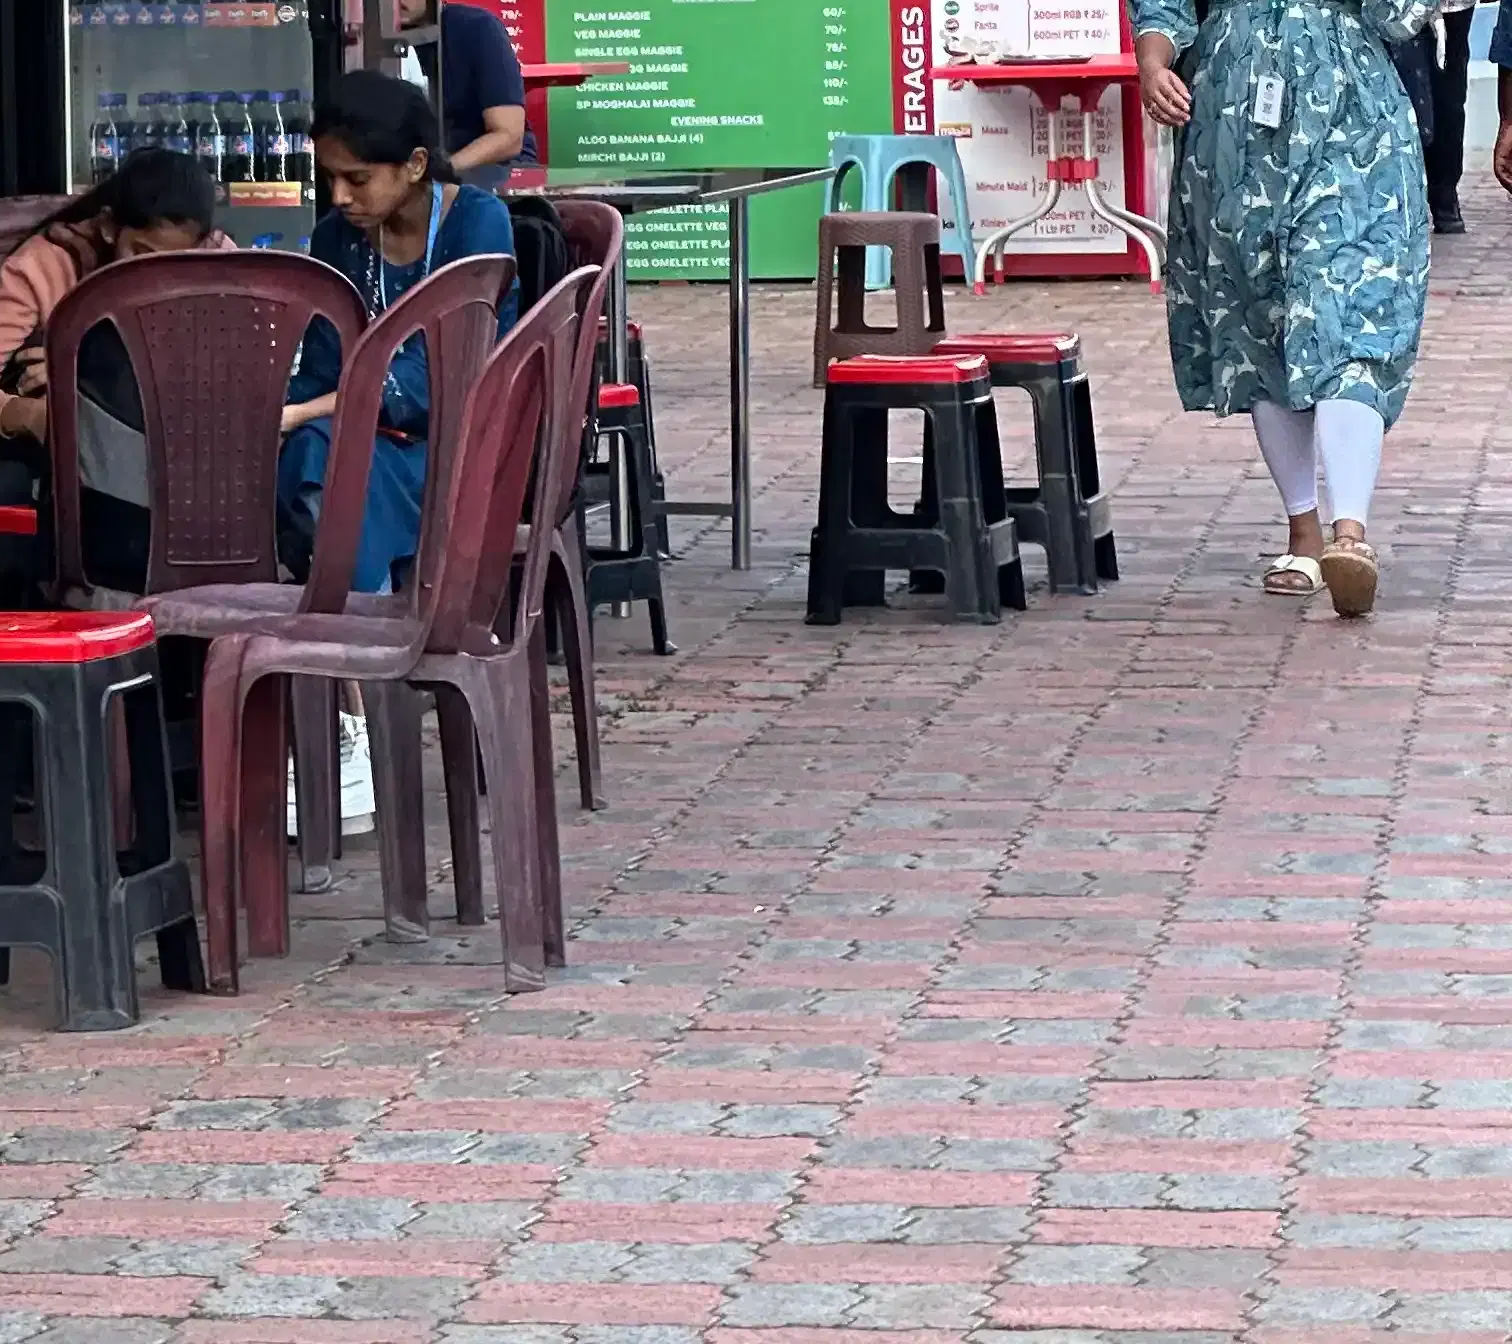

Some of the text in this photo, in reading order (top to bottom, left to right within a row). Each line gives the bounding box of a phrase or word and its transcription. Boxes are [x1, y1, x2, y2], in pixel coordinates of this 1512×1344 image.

[574, 12, 607, 22] PLAIN
[608, 11, 651, 21] MAGGIE
[974, 21, 998, 31] Fanta
[574, 30, 597, 39] VEG
[599, 29, 641, 39] MAGGIE
[575, 47, 614, 57] SINGLE
[616, 47, 638, 56] EGG
[640, 46, 683, 56] MAGGIE
[646, 63, 688, 73] MAGGIE
[576, 81, 623, 92] CHICKEN
[626, 81, 668, 91] MAGGIE
[653, 98, 696, 108] MAGGIE
[670, 114, 764, 127] EVENING SNACKS
[578, 135, 607, 145] ALOO
[610, 134, 655, 144] BANANA
[578, 153, 617, 162] MIRCHI
[646, 222, 702, 232] OMELETTE
[705, 221, 727, 232] VEG
[651, 239, 708, 250] OMELETTE
[651, 257, 709, 268] OMELETTE
